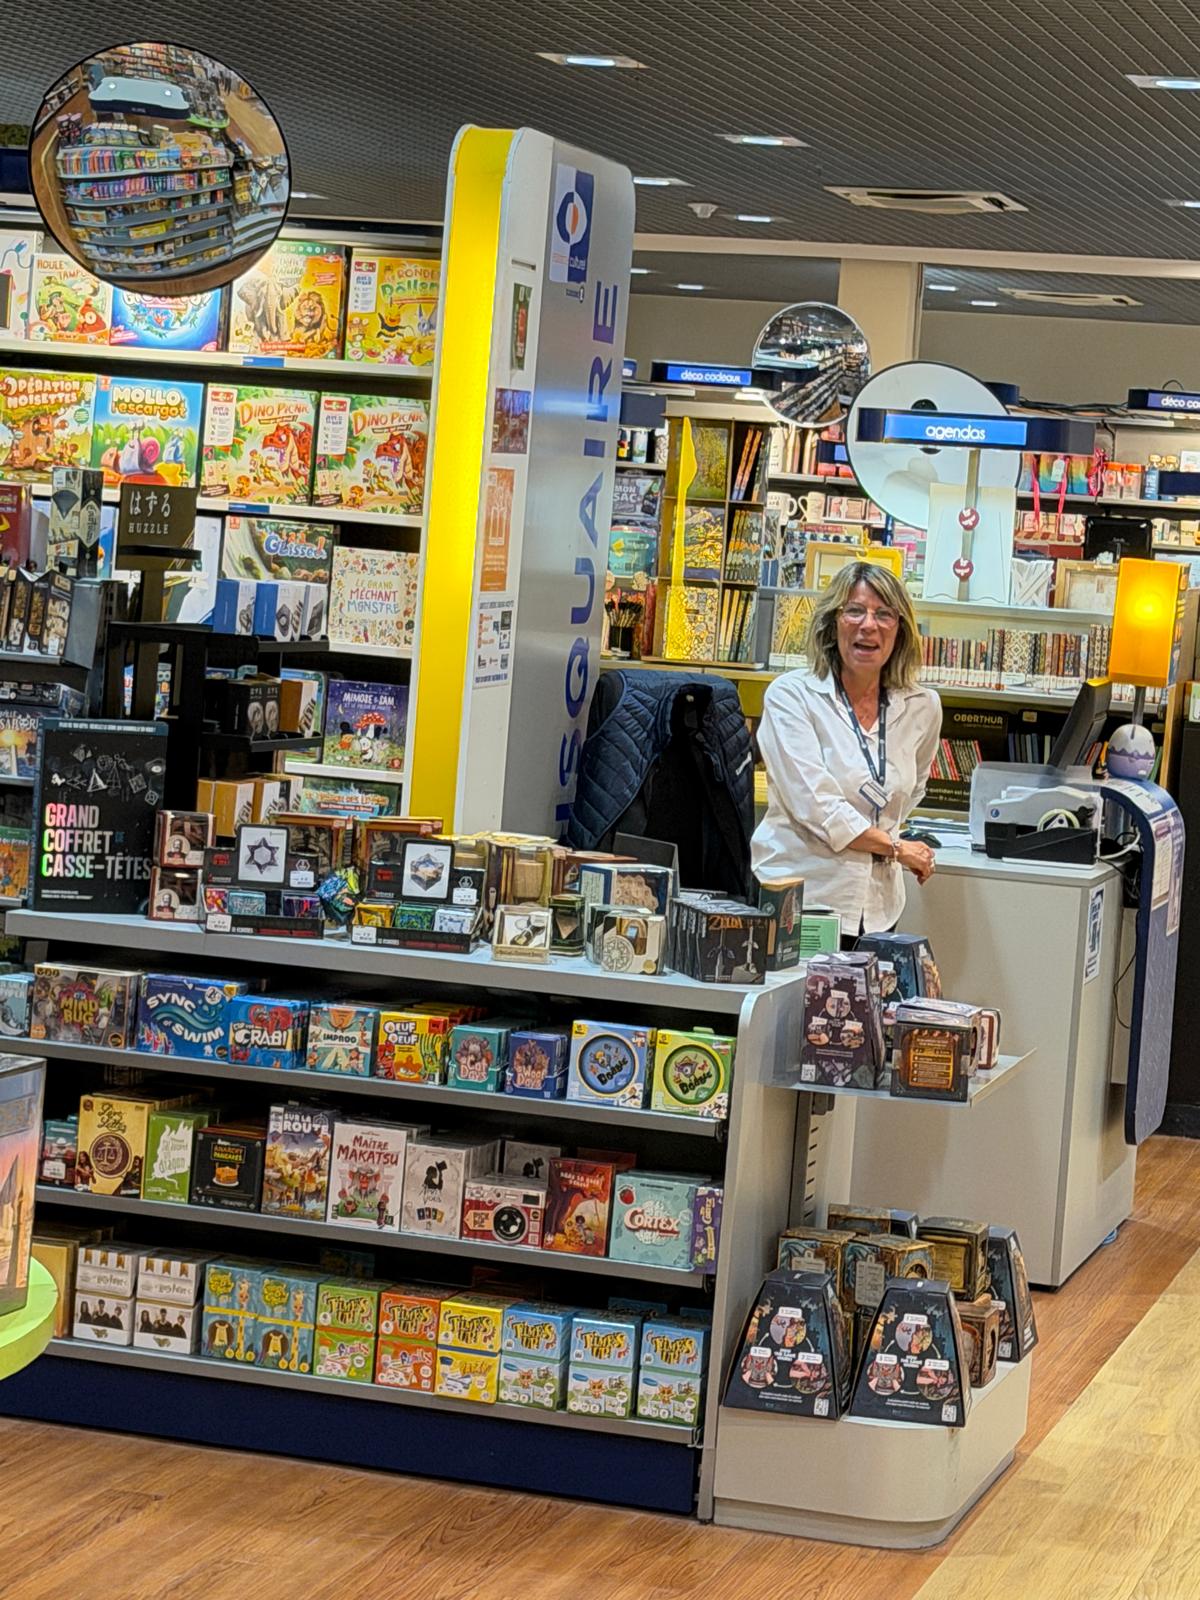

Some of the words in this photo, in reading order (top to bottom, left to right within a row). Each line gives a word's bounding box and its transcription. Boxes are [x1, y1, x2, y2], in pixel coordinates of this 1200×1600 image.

[112, 386, 182, 406] MOLLO
[925, 424, 986, 442] agendas
[614, 484, 637, 494] MON
[129, 491, 171, 517] はずる
[128, 522, 169, 535] HUZZLE
[350, 586, 399, 602] MÉCHANT
[953, 713, 1004, 725] OBERTHUR
[44, 803, 100, 828] GRAND
[43, 828, 113, 854] COFFRET
[41, 852, 151, 880] CASSE-TÊTES
[60, 997, 99, 1012] MIND
[147, 992, 196, 1012] SYNC
[63, 1009, 94, 1025] BUG
[171, 1026, 225, 1044] SWIM
[301, 1113, 312, 1123] LA
[283, 1121, 330, 1135] ROUTE
[336, 1144, 399, 1166] MAKATSU
[624, 1207, 681, 1232] CORTEX
